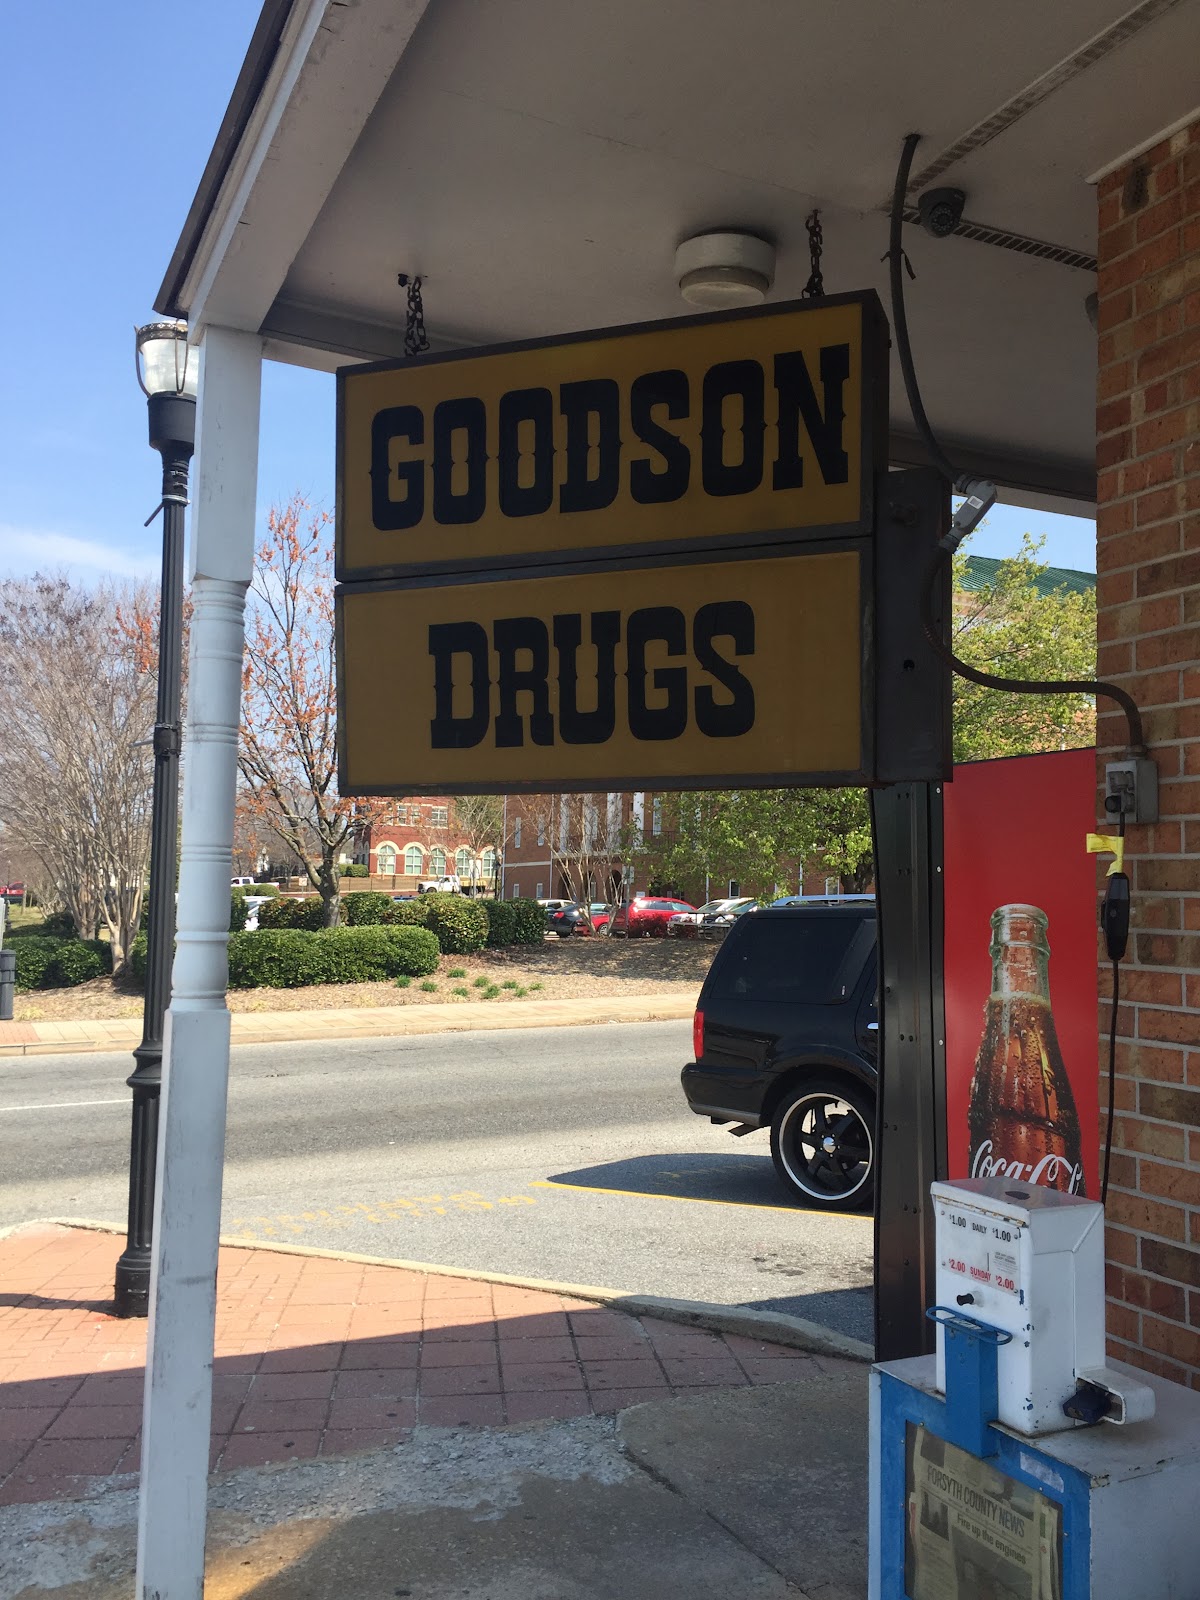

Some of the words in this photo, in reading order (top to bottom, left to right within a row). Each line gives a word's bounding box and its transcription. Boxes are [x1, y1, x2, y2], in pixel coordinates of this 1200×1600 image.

[369, 343, 850, 531] GOODSON
[428, 600, 756, 749] DRUGS
[949, 1214, 966, 1228] $1.00
[972, 1222, 988, 1234] DAILY
[992, 1228, 1012, 1242] $1.00
[948, 1258, 966, 1273] $2.00
[970, 1266, 991, 1281] SUNDAY
[995, 1275, 1014, 1291] $2.00
[927, 1465, 963, 1501] FORSYTH
[963, 1487, 998, 1521] COUNTY
[998, 1507, 1025, 1538] NEWS
[957, 1513, 971, 1530] Fire
[971, 1524, 981, 1538] up
[982, 1529, 994, 1545] the
[995, 1540, 1026, 1565] engines
